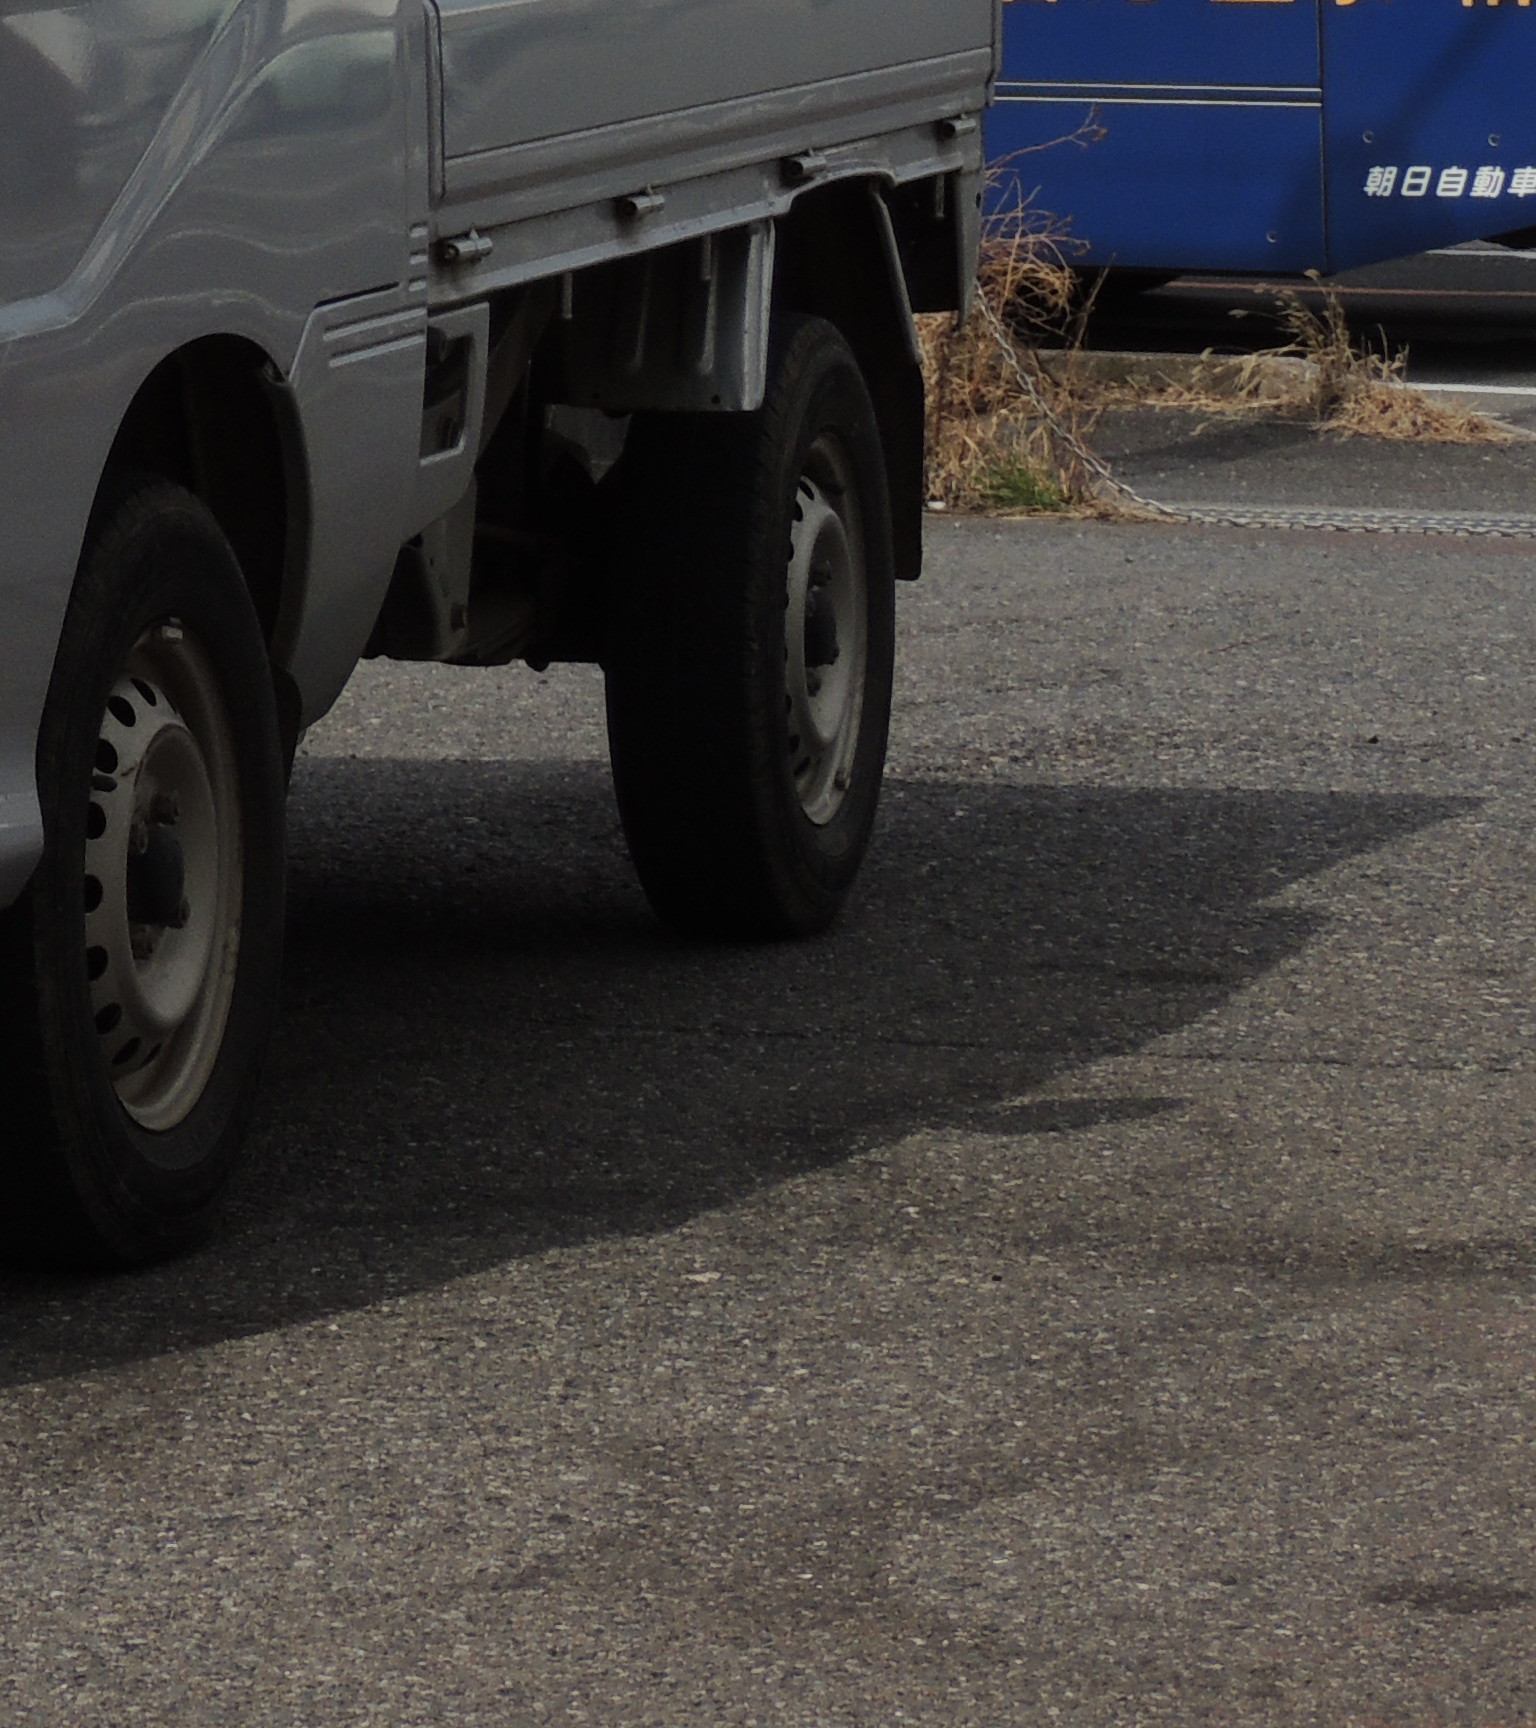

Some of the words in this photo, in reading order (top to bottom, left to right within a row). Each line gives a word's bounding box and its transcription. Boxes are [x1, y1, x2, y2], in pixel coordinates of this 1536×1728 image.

[1363, 165, 1536, 198] 朝日自動車
